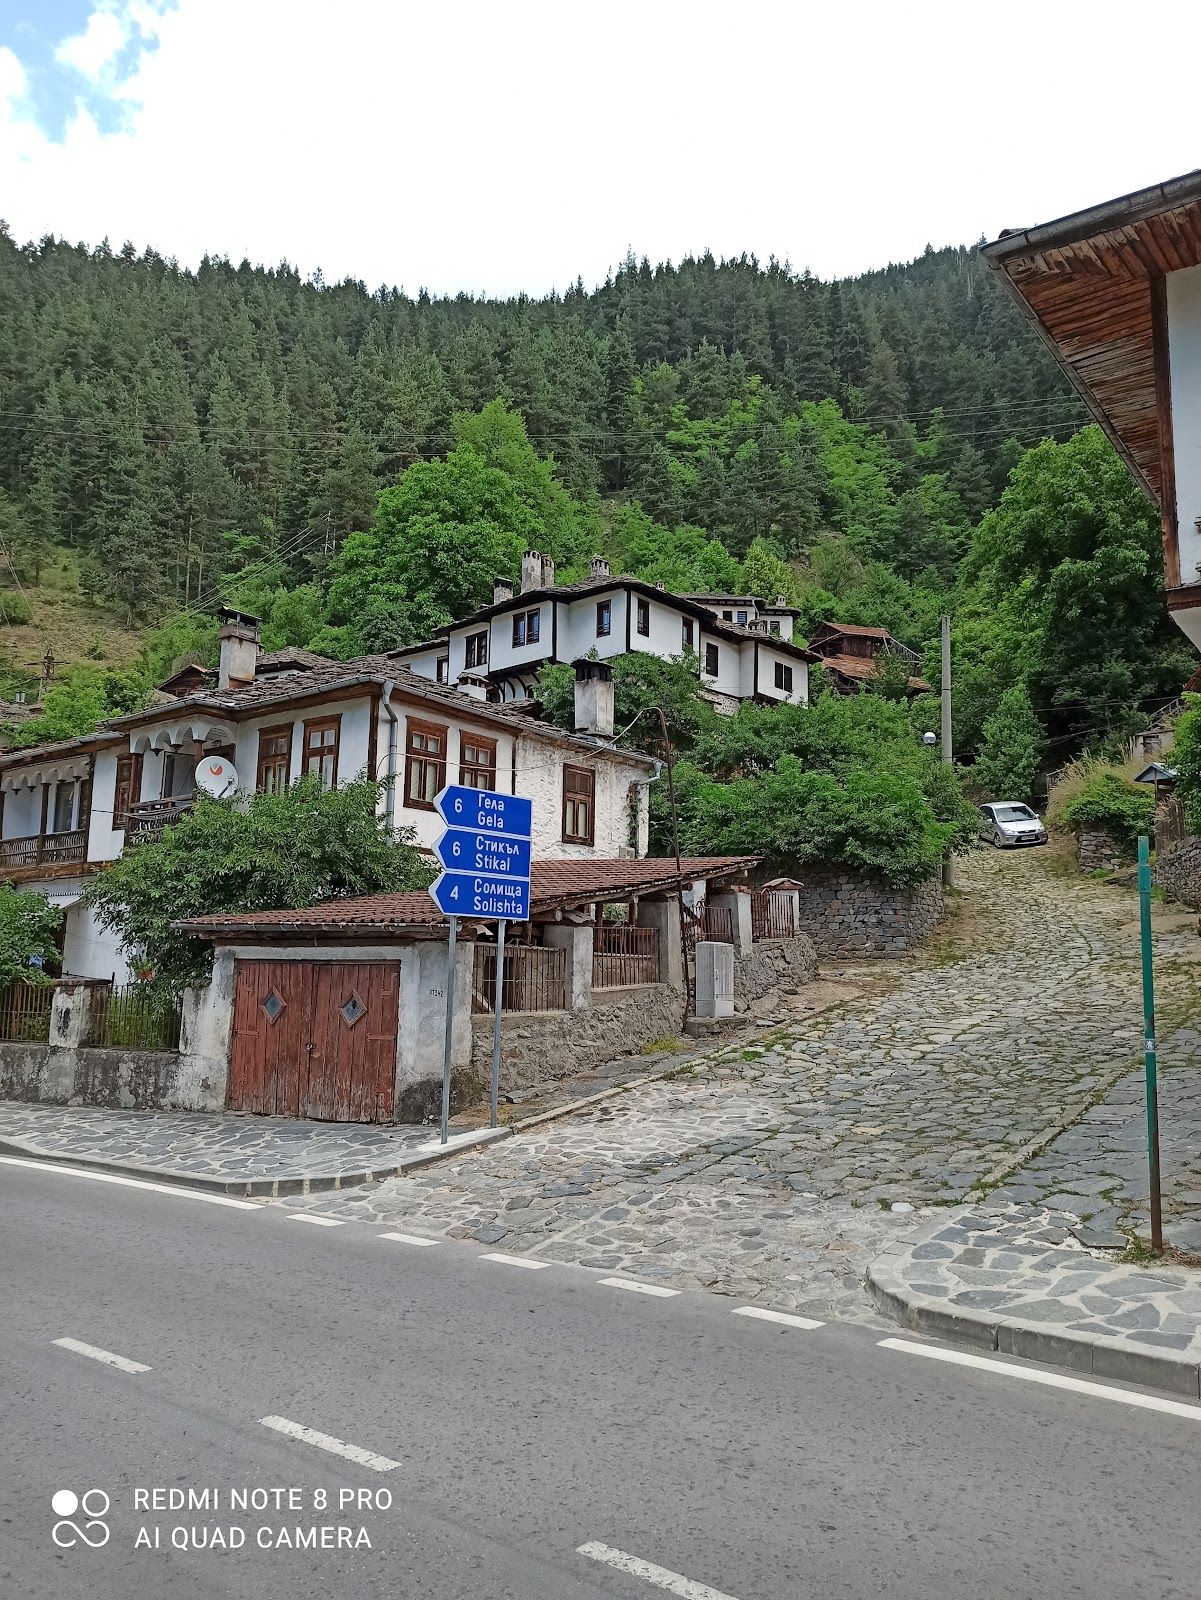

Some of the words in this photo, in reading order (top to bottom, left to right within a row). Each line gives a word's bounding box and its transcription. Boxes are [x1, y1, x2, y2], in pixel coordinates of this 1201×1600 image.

[454, 798, 463, 813] 6
[478, 794, 505, 812] Гела
[477, 811, 504, 829] Gela
[452, 841, 461, 857] 6
[476, 836, 520, 856] Стикъл
[475, 853, 510, 872] Stikal
[450, 885, 459, 900] 4
[474, 878, 522, 898] Солища
[473, 896, 523, 914] Solishta
